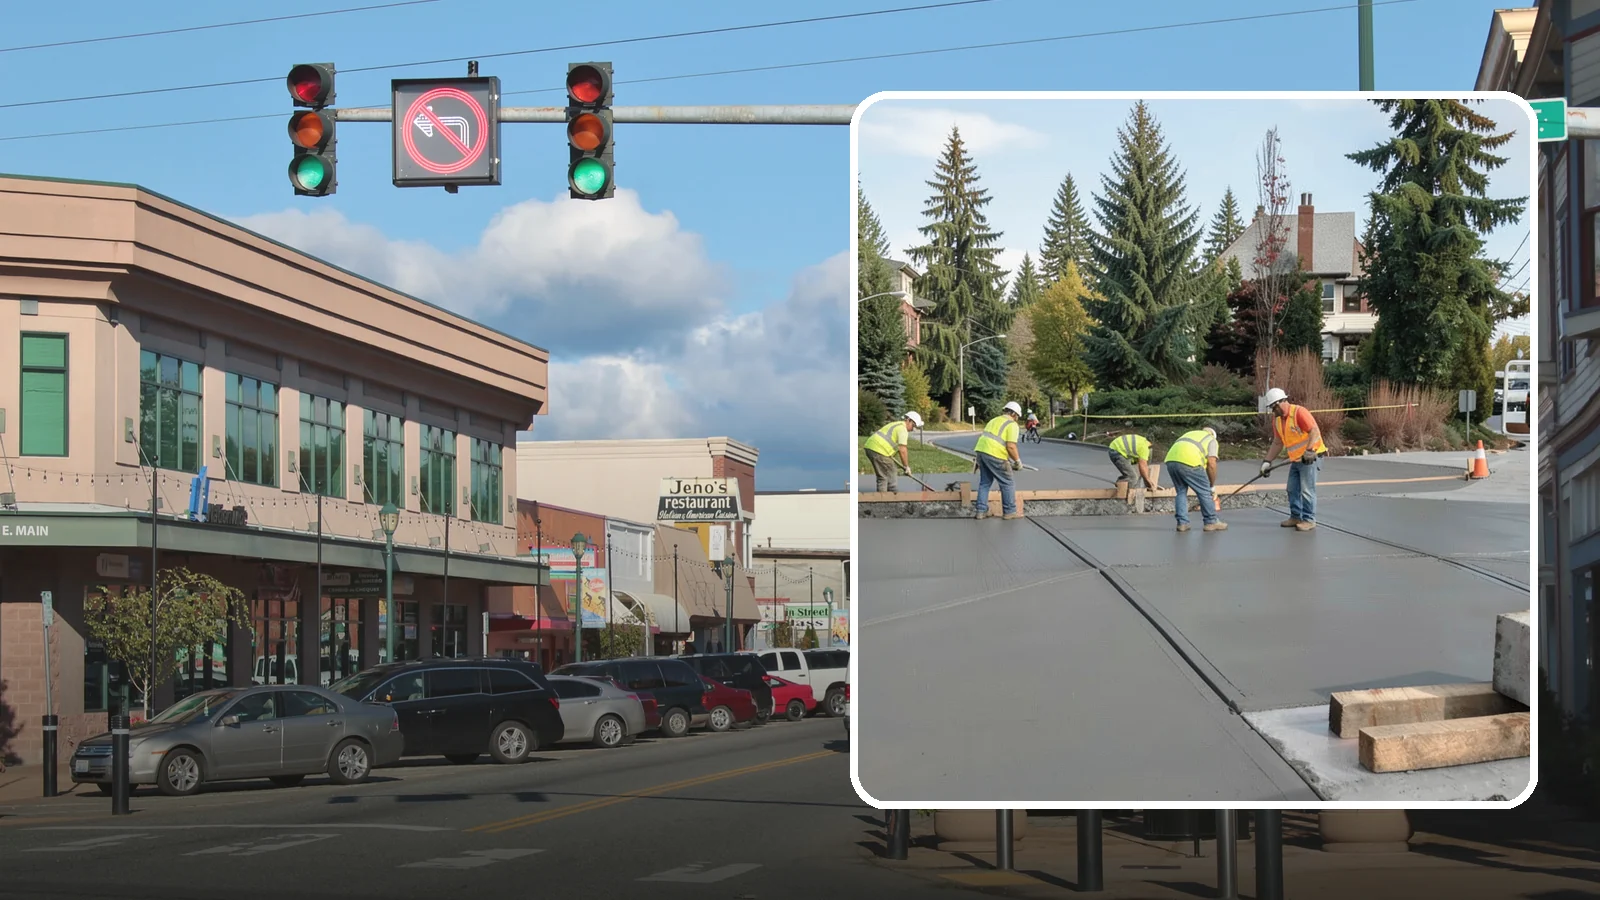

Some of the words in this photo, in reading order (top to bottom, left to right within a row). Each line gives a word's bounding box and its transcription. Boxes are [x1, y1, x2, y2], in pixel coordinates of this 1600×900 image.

[670, 480, 727, 494] Jeno's
[665, 496, 731, 509] restaurant
[659, 510, 681, 519] Italian
[687, 510, 714, 519] American
[715, 510, 737, 519] Cuisine
[2, 525, 13, 536] E.
[15, 525, 49, 536] MAIN
[797, 607, 829, 616] Street
